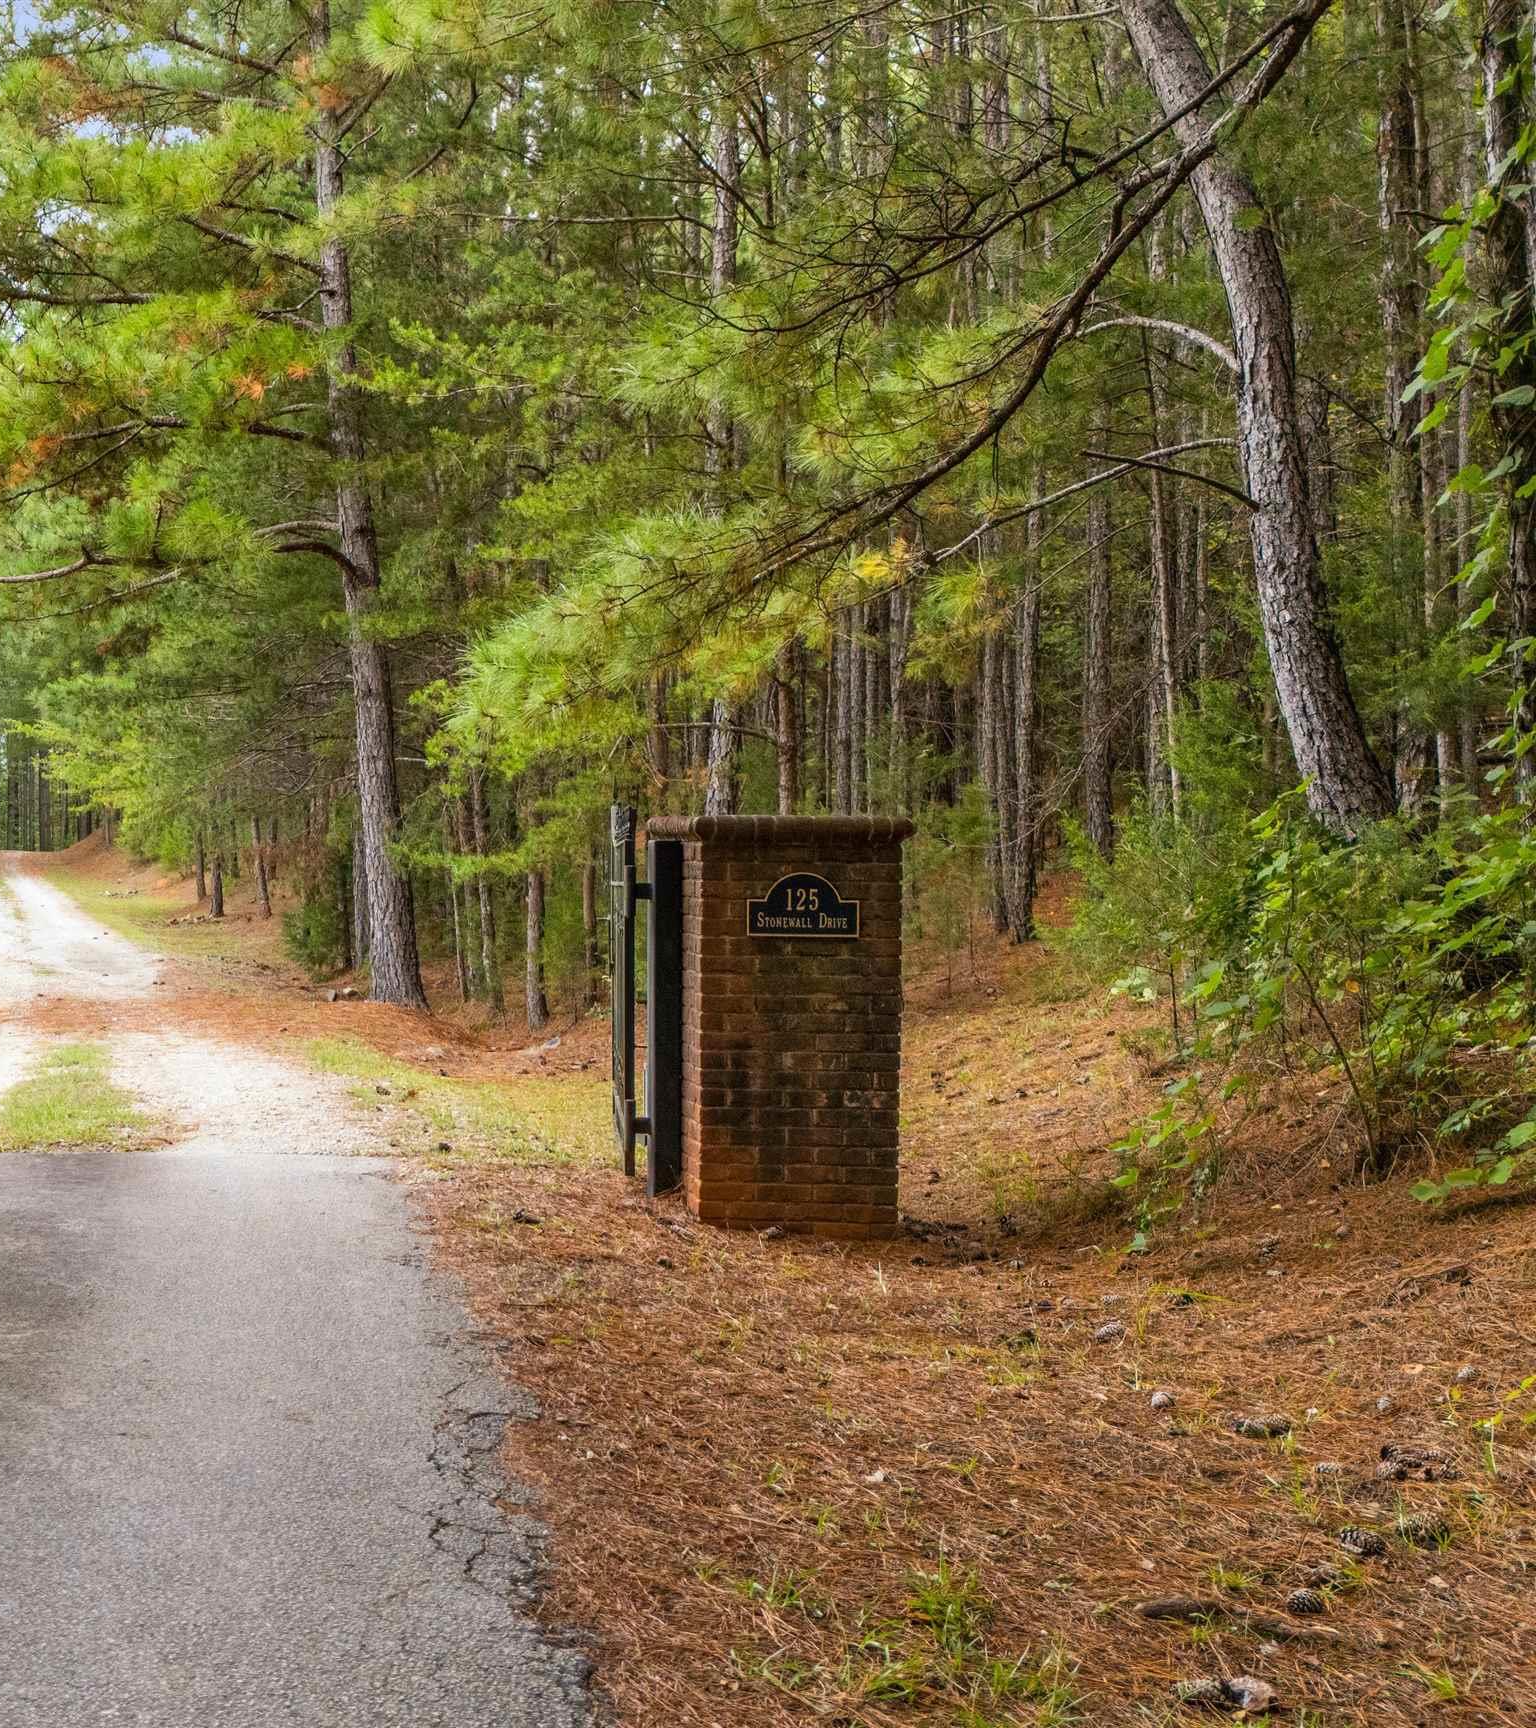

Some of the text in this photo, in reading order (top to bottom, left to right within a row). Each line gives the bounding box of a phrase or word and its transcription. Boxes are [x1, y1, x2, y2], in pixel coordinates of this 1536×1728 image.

[786, 888, 819, 911] 125
[756, 911, 848, 929] STONEWALL DRIVE
